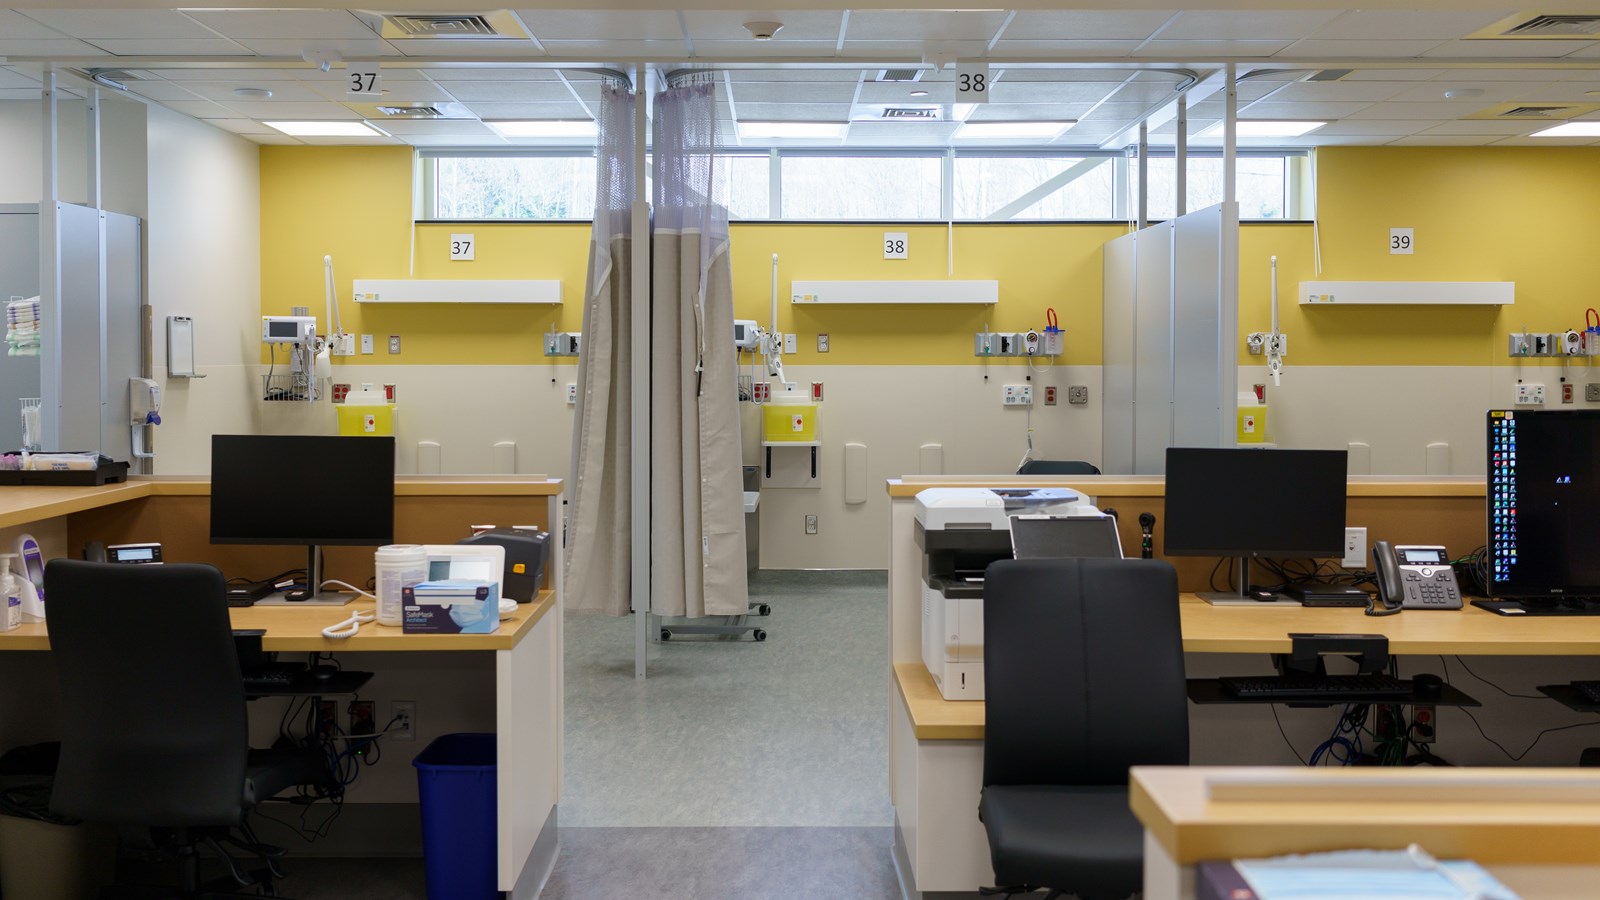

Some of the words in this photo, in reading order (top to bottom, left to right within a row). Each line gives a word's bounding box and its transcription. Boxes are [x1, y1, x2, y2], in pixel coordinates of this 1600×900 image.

[351, 73, 377, 92] 37
[959, 73, 985, 92] 38
[452, 241, 471, 255] 37
[885, 240, 904, 254] 38
[1391, 235, 1410, 249] 39
